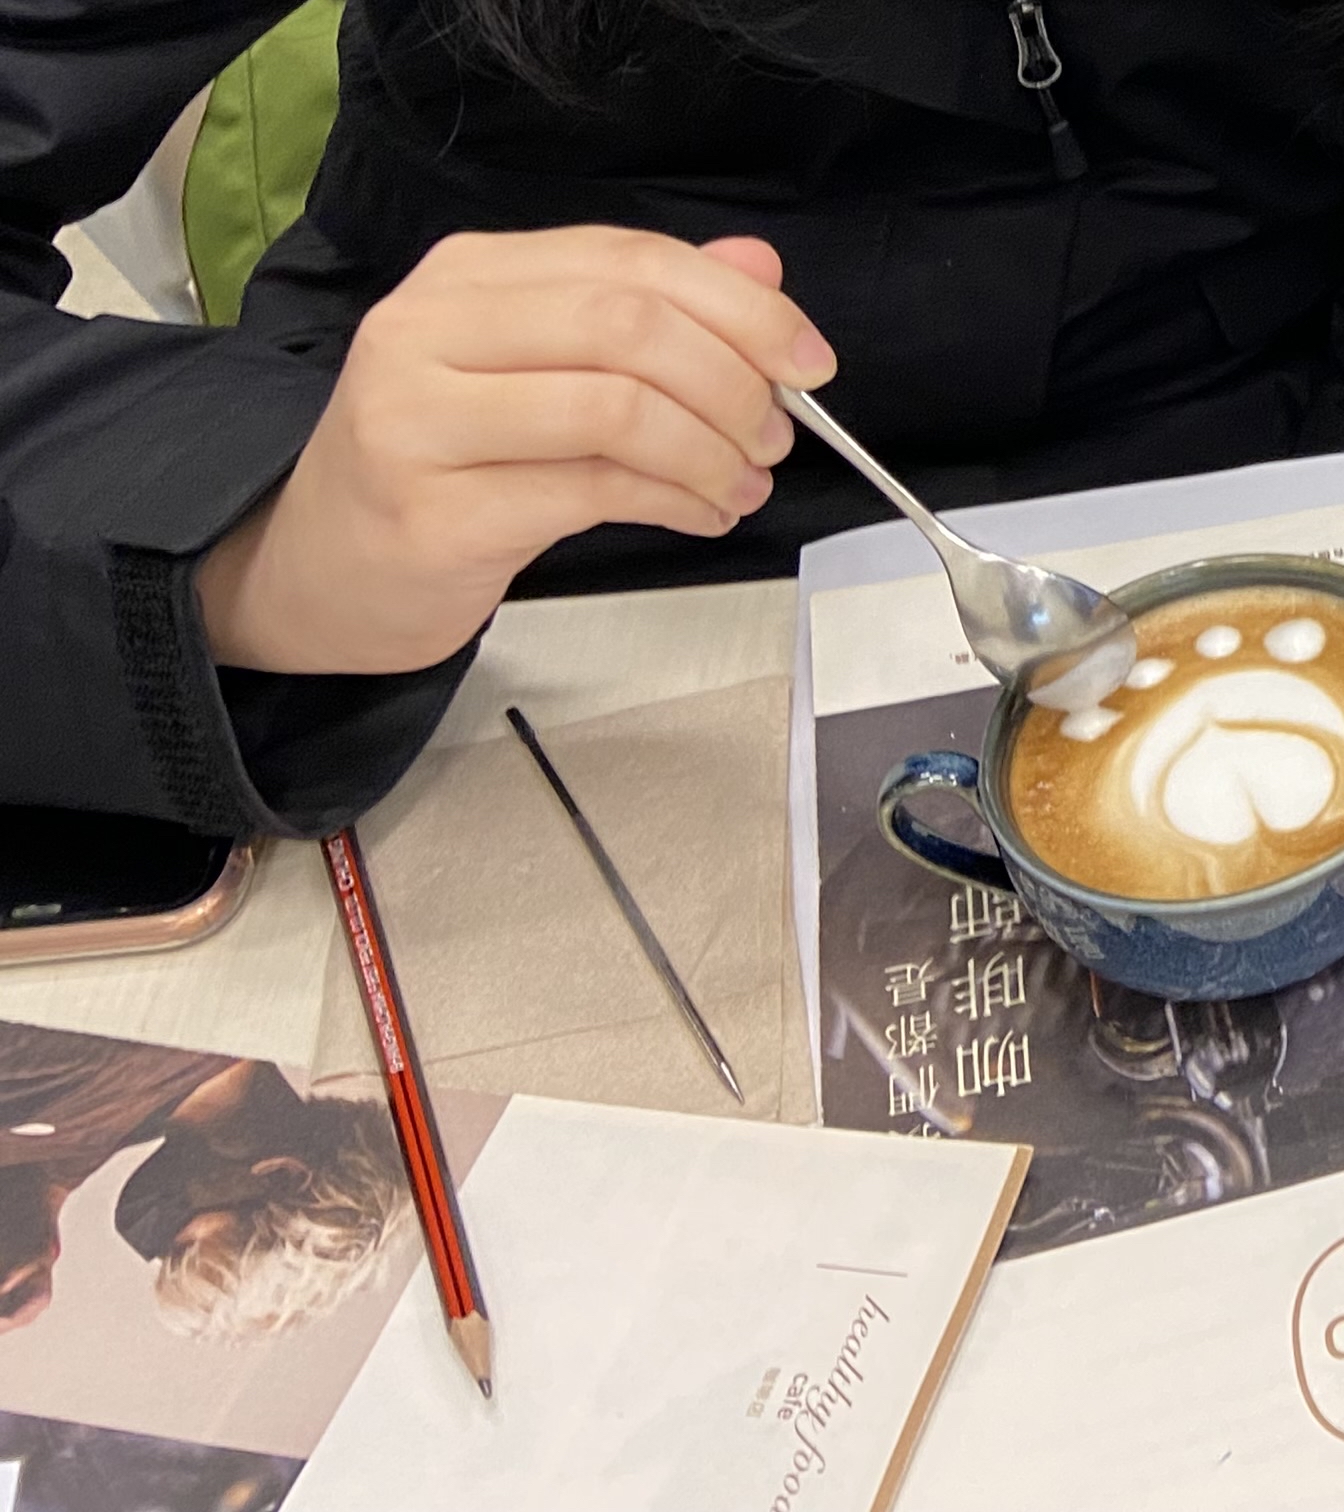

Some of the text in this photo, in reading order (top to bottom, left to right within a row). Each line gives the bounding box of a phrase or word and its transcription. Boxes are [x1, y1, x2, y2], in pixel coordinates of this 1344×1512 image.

[949, 885, 1031, 1097] 咖啡師
[777, 1373, 808, 1421] cafe
